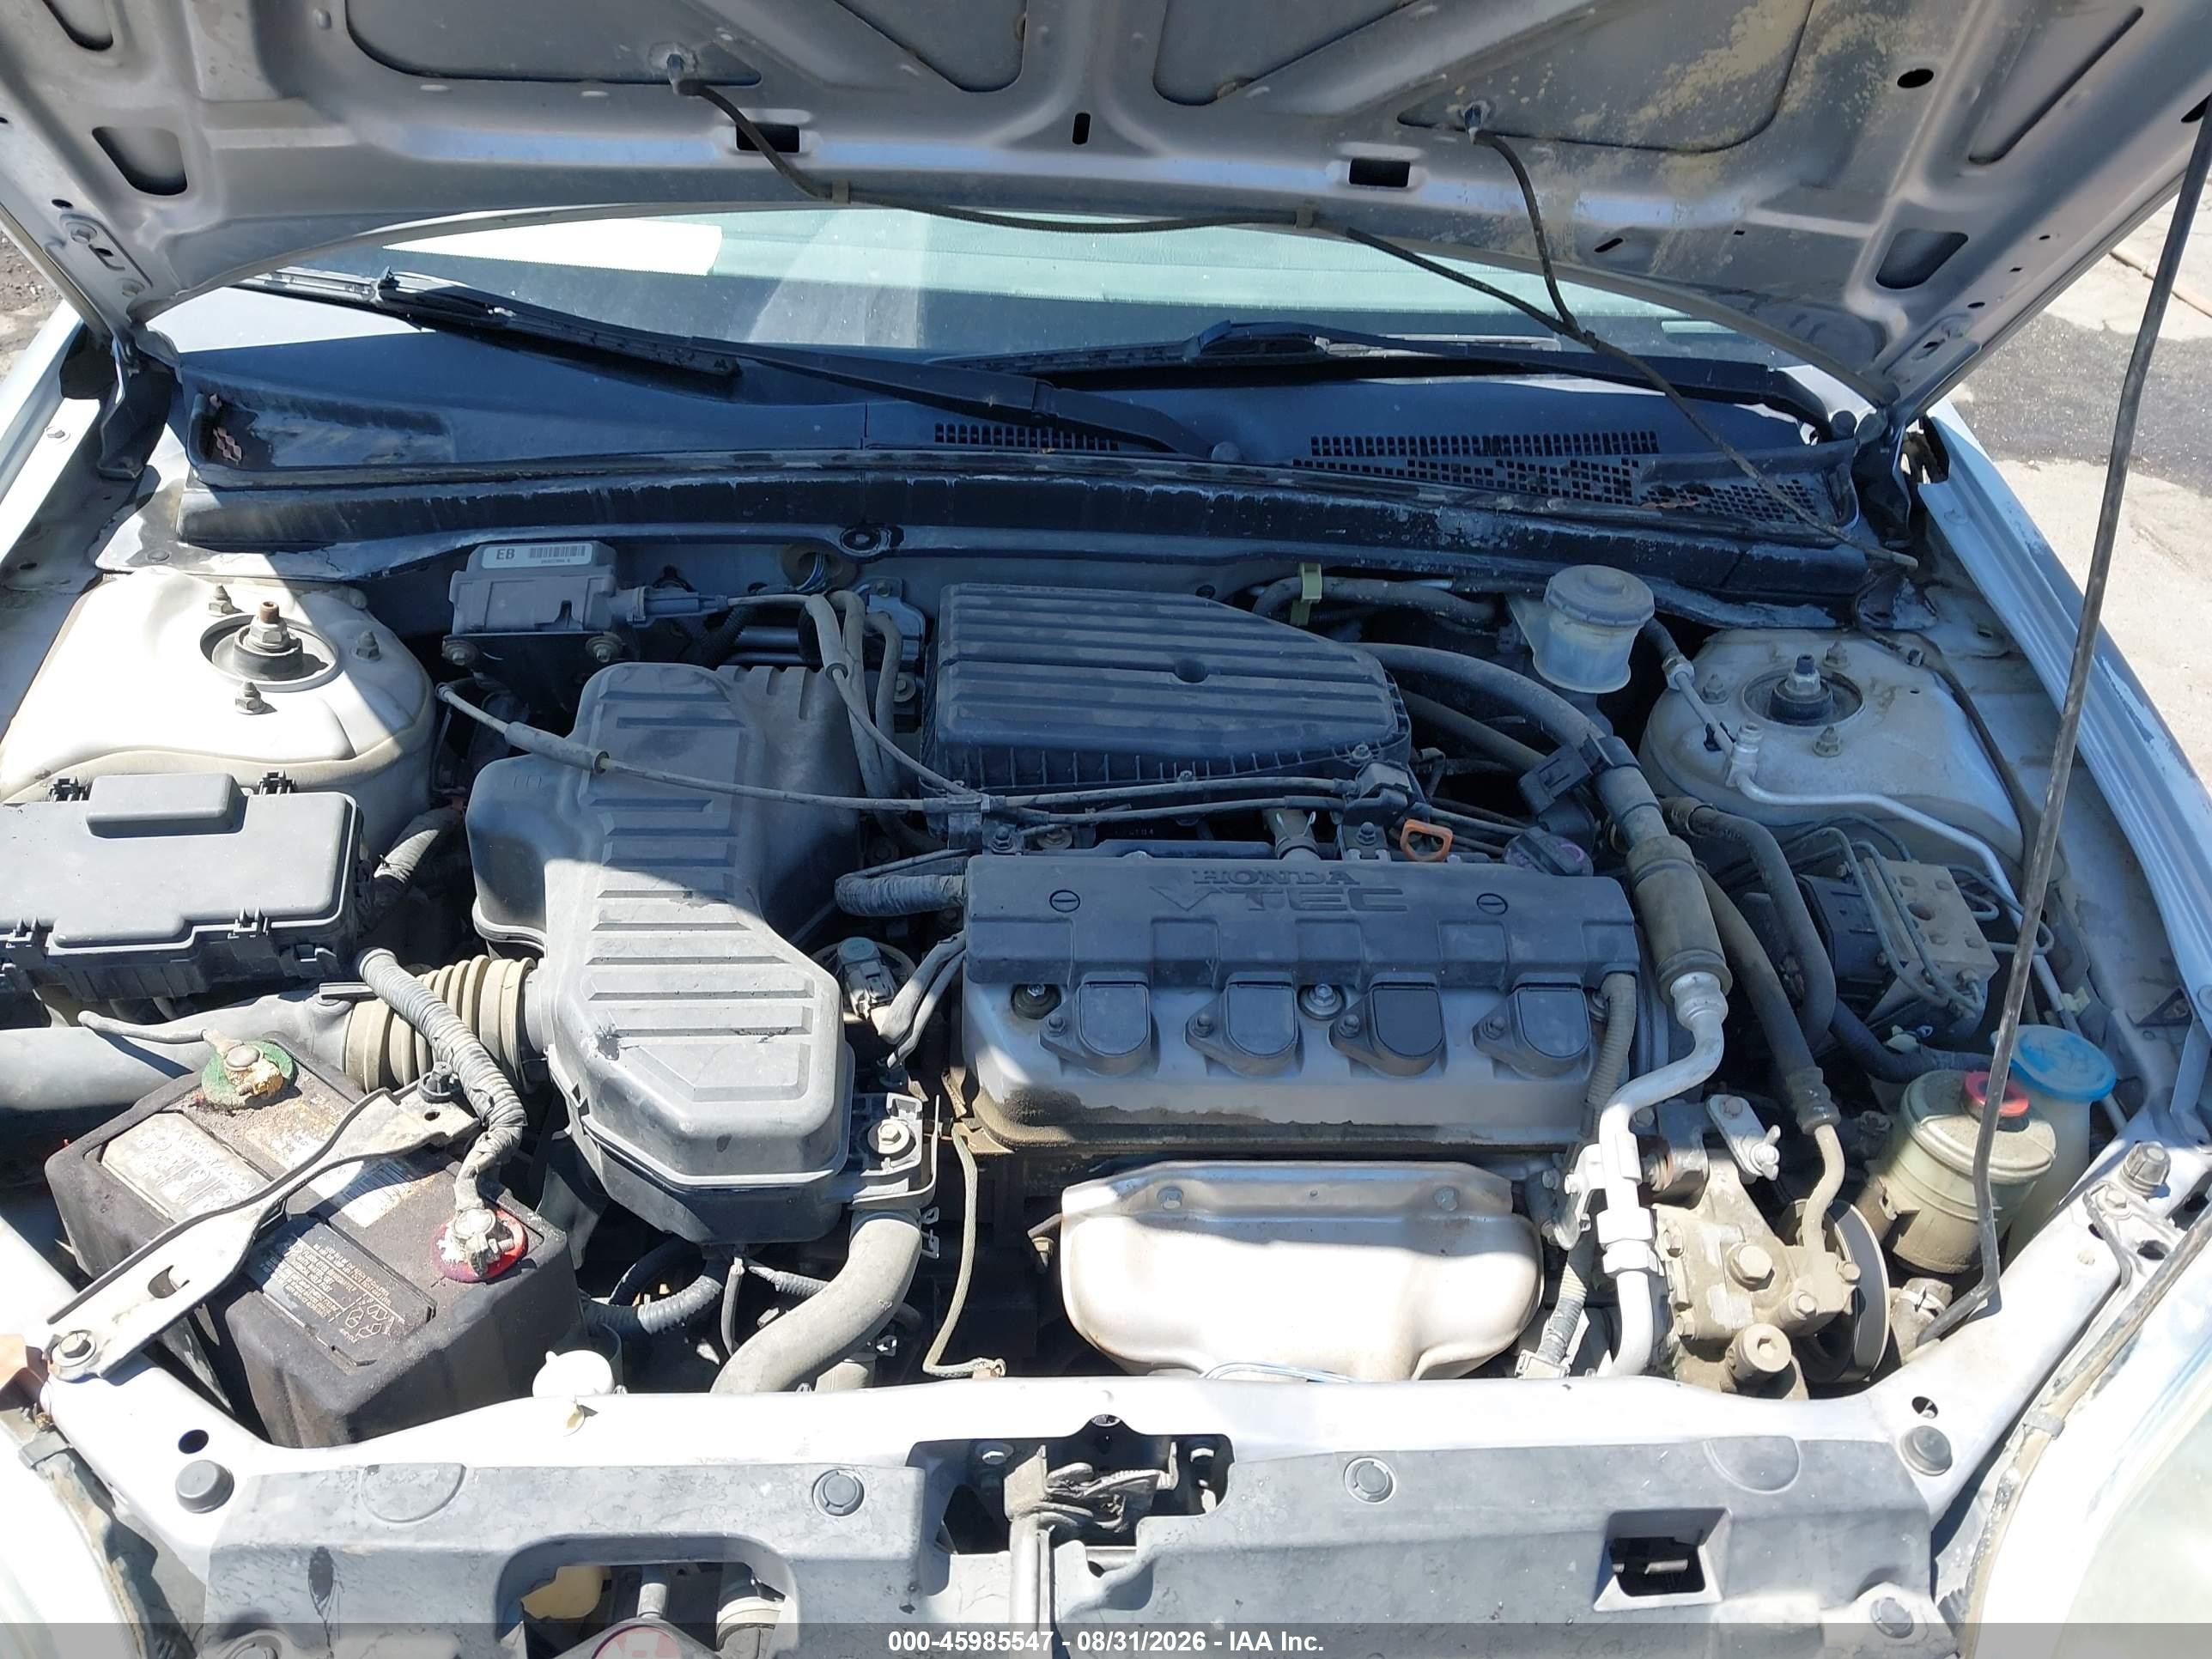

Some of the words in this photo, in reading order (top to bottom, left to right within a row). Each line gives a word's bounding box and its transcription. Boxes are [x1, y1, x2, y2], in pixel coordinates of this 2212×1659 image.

[495, 548, 515, 560] EB
[1192, 869, 1361, 885] HONDA
[1148, 885, 1409, 912] VTEC
